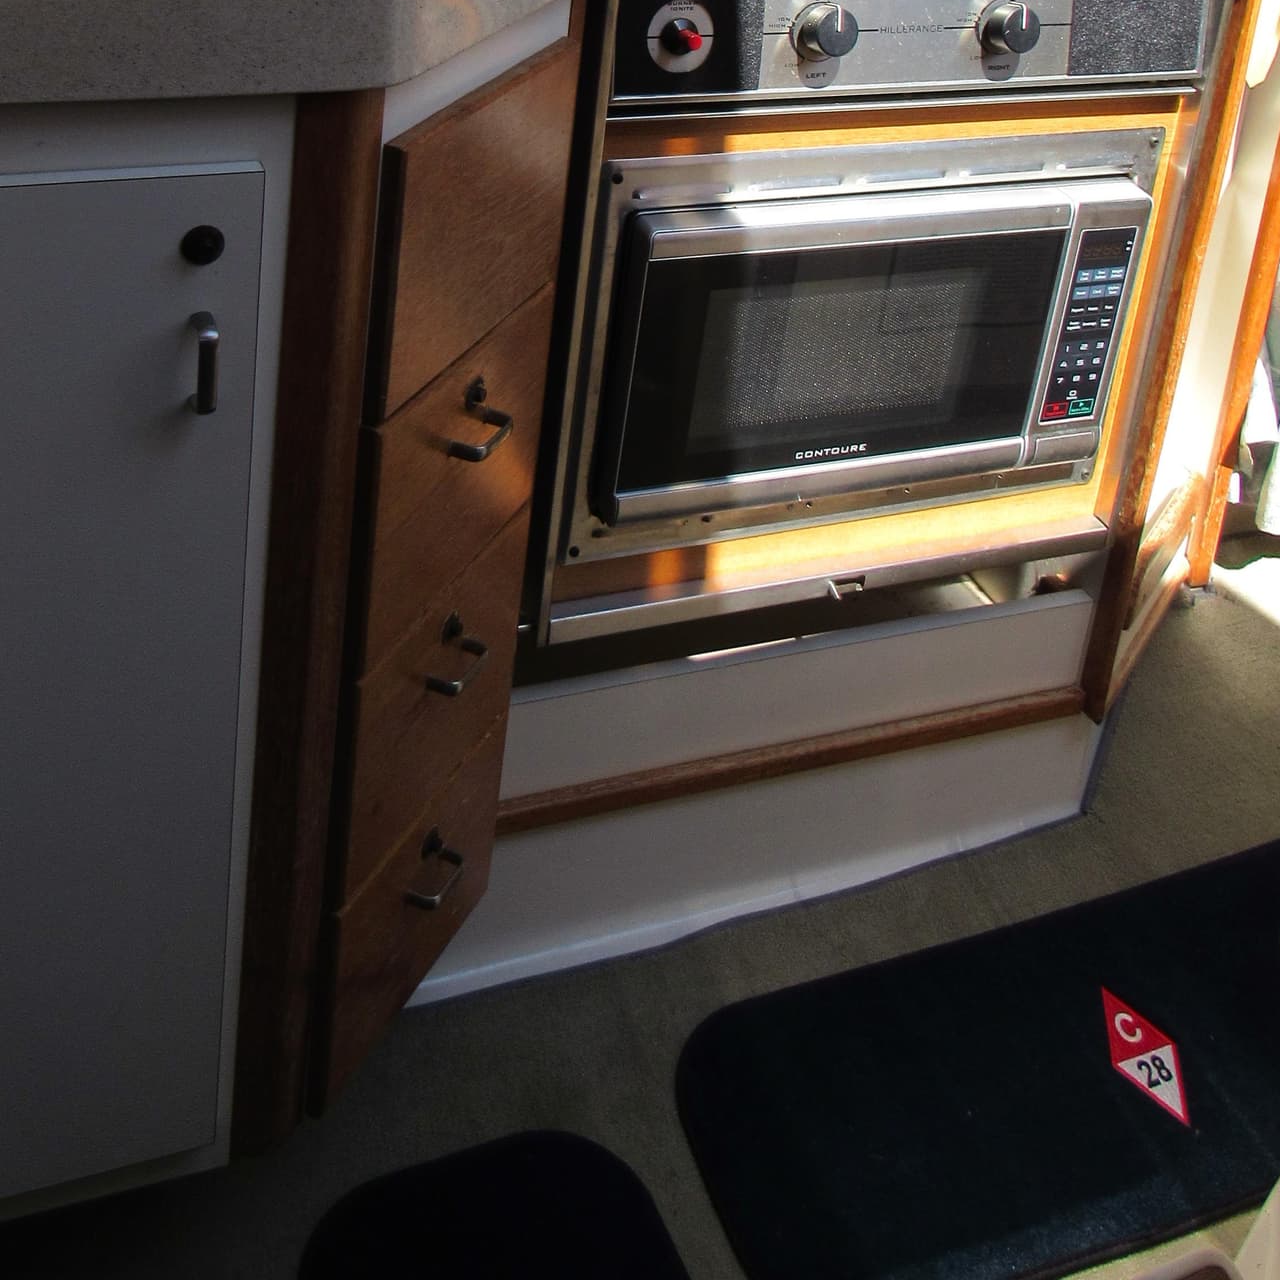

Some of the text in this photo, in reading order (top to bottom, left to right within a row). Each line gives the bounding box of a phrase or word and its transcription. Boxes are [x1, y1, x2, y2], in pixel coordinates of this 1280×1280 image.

[880, 24, 943, 34] HILLERANGE
[805, 71, 827, 79] LEFT
[1065, 341, 1105, 353] 1 2 3
[1092, 357, 1101, 365] 6
[1068, 389, 1078, 397] 0
[795, 443, 868, 460] CONTOURE
[1114, 1012, 1143, 1043] C
[1136, 1054, 1173, 1089] 28
